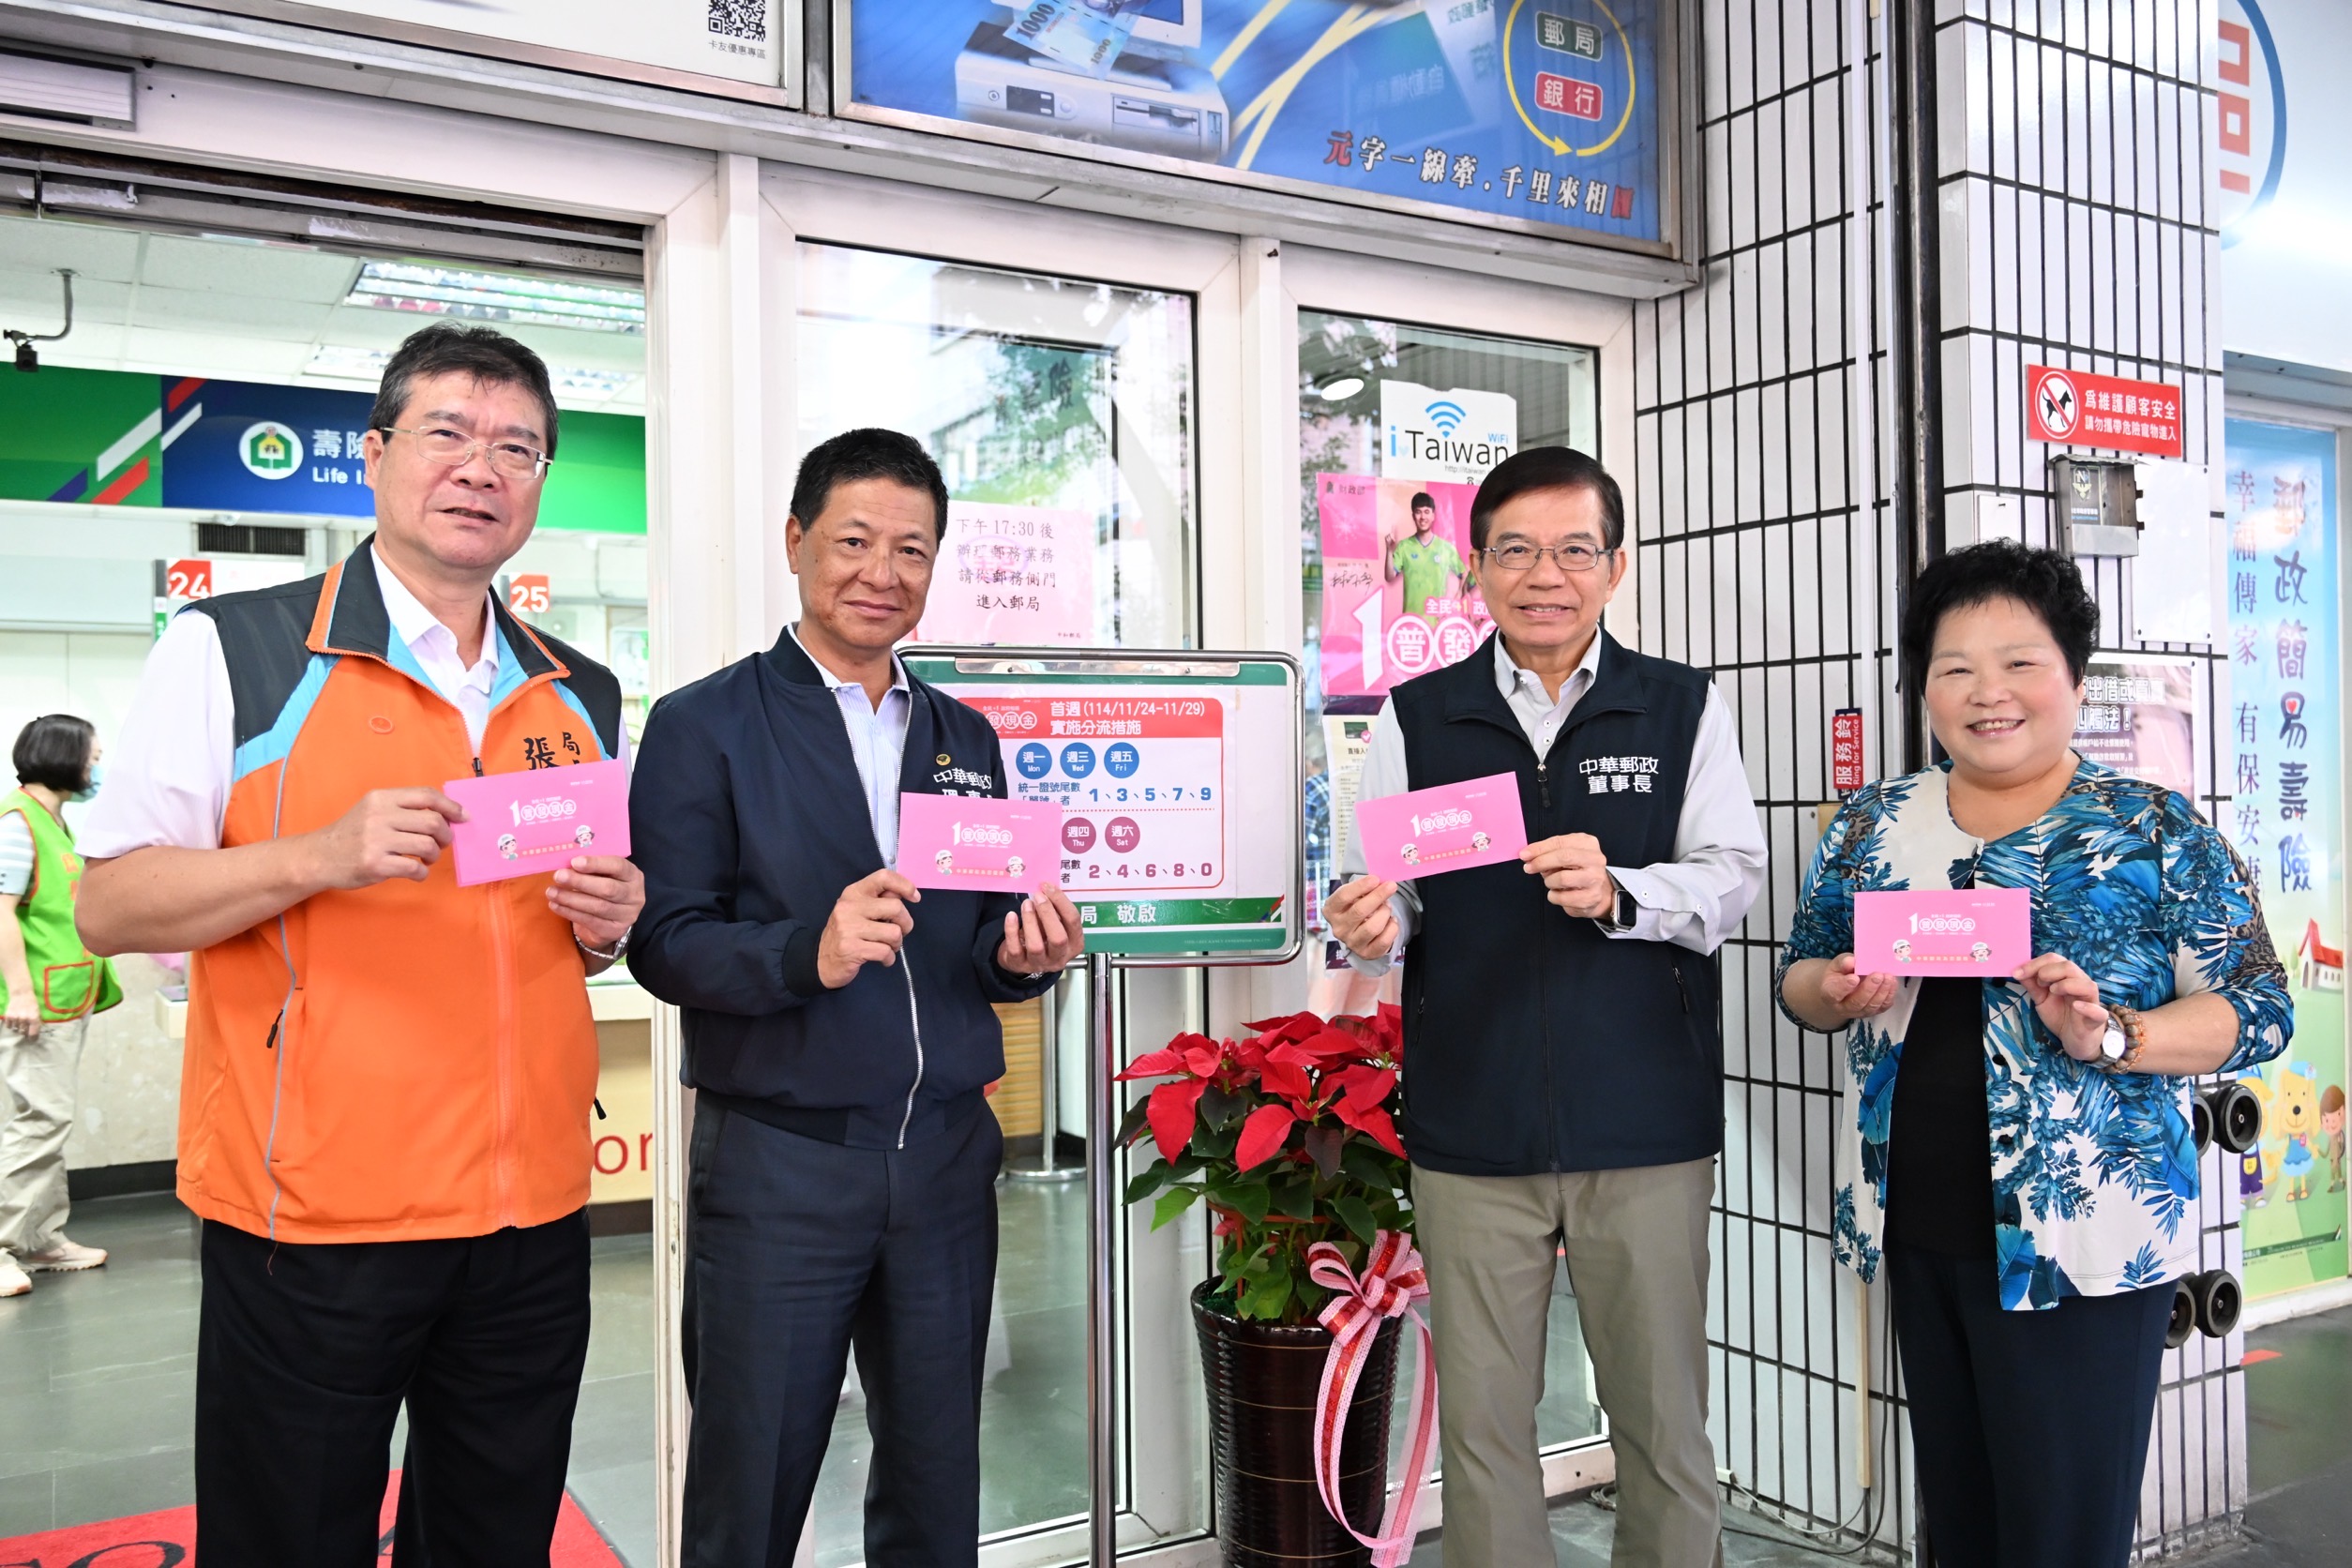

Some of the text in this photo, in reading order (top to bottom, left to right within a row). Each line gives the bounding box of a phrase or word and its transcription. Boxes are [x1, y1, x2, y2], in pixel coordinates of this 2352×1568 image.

[1016, 2, 1056, 40] 1000
[1544, 19, 1595, 55] 郵局
[1090, 38, 1112, 66] 1000
[1544, 79, 1595, 115] 銀行
[312, 466, 348, 484] Life
[958, 568, 1056, 588] 請從郵務側門
[2232, 471, 2258, 667] 幸福傳家
[170, 571, 211, 598] 24
[511, 585, 549, 613] 25
[976, 595, 1040, 611] 進入郵局
[2273, 475, 2313, 894] 郵政簡易壽險
[1050, 701, 1205, 717] 首週(114/11/24-11/29)
[1050, 720, 1141, 735] 實施分流措施
[523, 737, 560, 770] 張
[1023, 751, 1046, 763] 週一
[1066, 751, 1089, 762] 週三
[1110, 750, 1133, 762] 週五
[1834, 718, 1852, 785] 服務鈴
[1579, 756, 1659, 775] 中華郵政
[1018, 782, 1080, 792] 統一證號尾數
[1588, 774, 1652, 794] 董事長
[1067, 826, 1089, 837] 週四
[1111, 825, 1134, 837] 週六
[1061, 873, 1071, 883] 者
[1080, 904, 1156, 924] 局 敬啟
